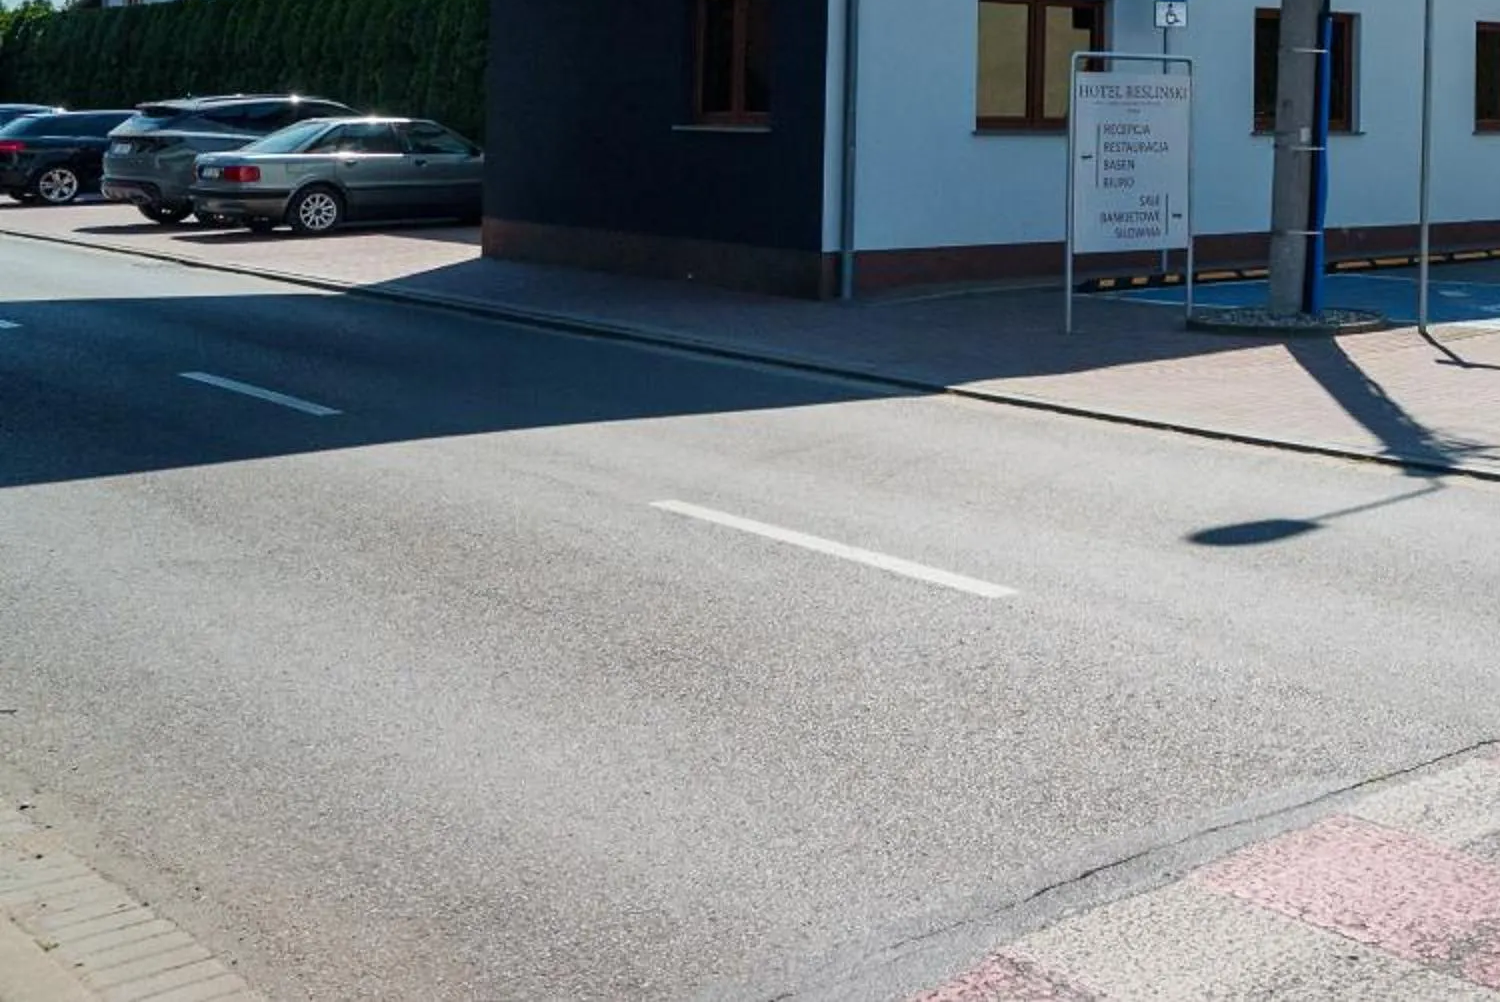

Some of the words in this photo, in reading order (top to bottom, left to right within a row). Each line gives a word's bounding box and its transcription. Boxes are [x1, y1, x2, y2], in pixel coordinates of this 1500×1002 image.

[1079, 84, 1123, 99] HOTEL
[1103, 123, 1151, 135] RECEPCJA
[1103, 141, 1169, 153] RESTAURACJA
[1103, 159, 1135, 171] BASEN
